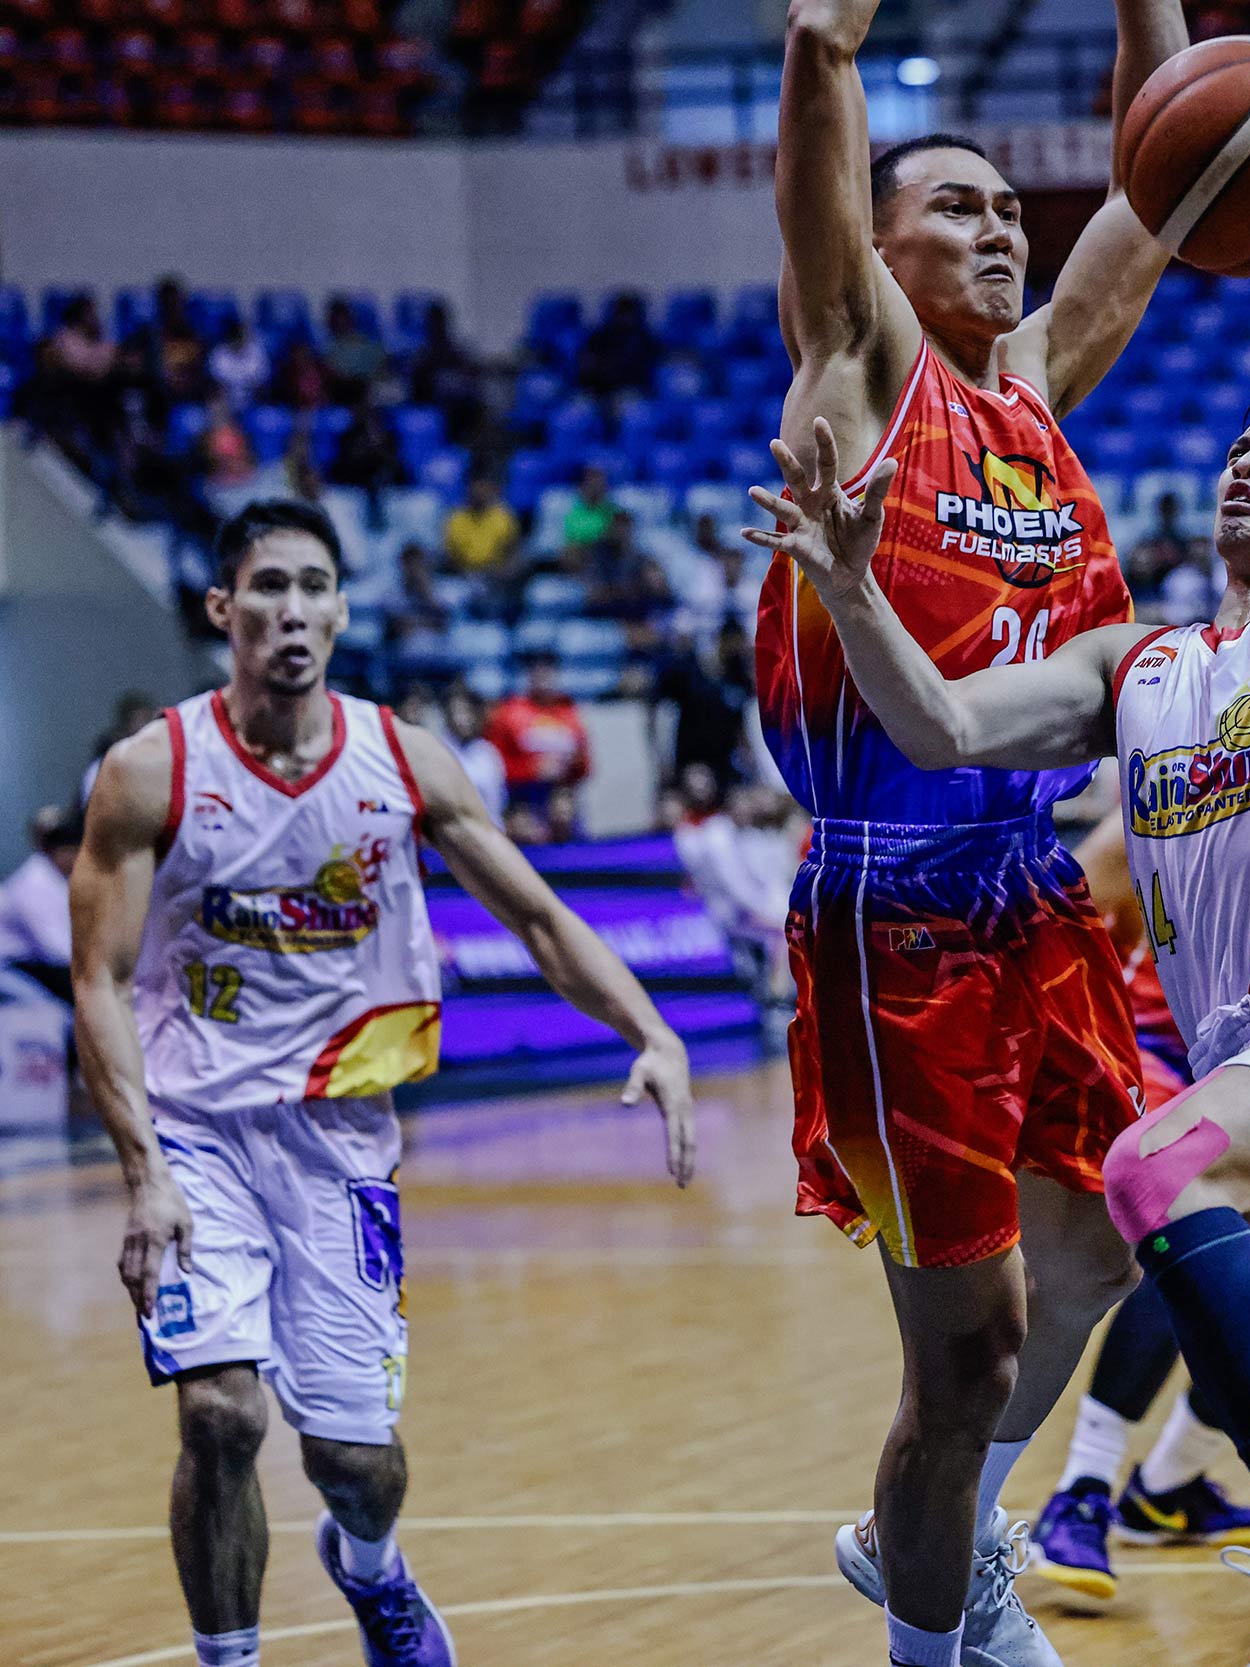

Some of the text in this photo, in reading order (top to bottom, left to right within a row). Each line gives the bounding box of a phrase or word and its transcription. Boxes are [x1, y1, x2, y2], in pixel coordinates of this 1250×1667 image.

[1134, 656, 1166, 669] ANTA
[888, 926, 937, 952] PBA
[184, 962, 244, 1024] 12
